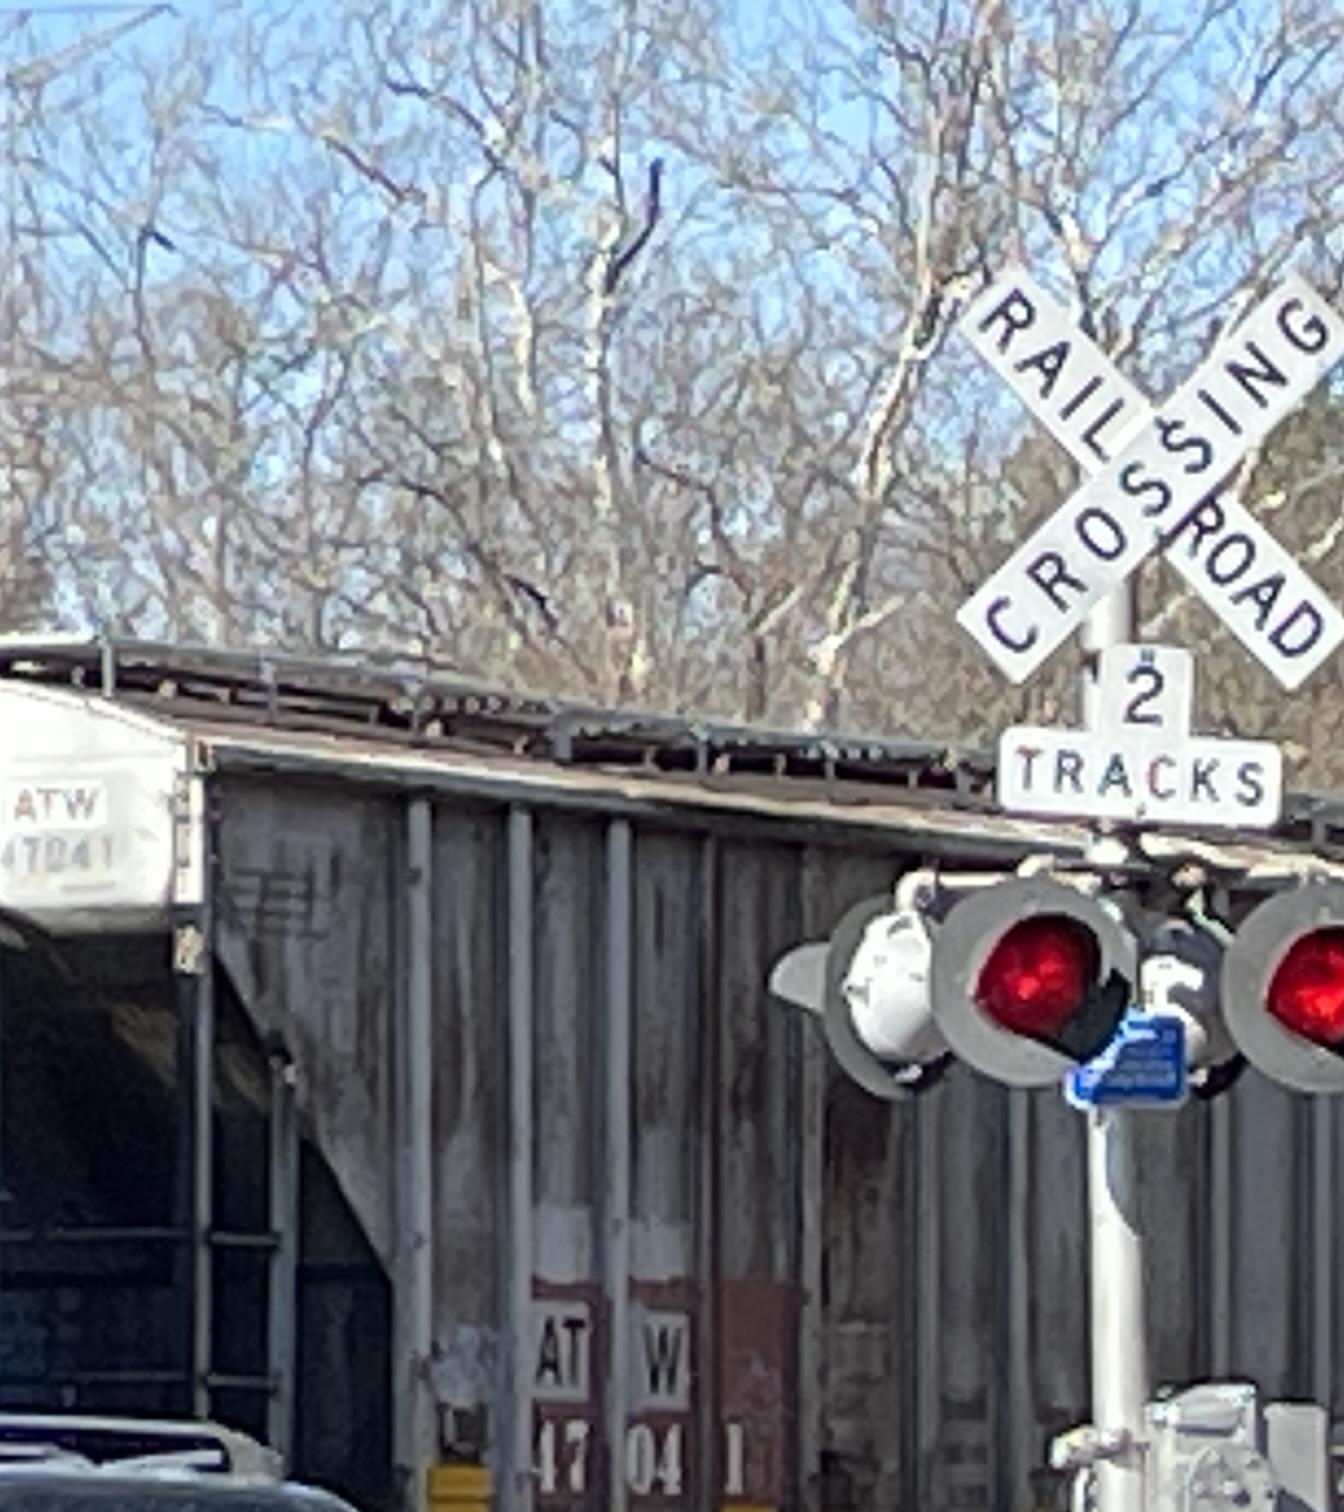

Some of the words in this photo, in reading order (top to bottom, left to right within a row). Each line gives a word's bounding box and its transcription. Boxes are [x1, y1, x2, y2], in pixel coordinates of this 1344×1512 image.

[986, 297, 1329, 654] CROSSING
[1123, 666, 1165, 725] 2
[14, 788, 101, 822] ATW
[1016, 746, 1265, 807] TRACKS
